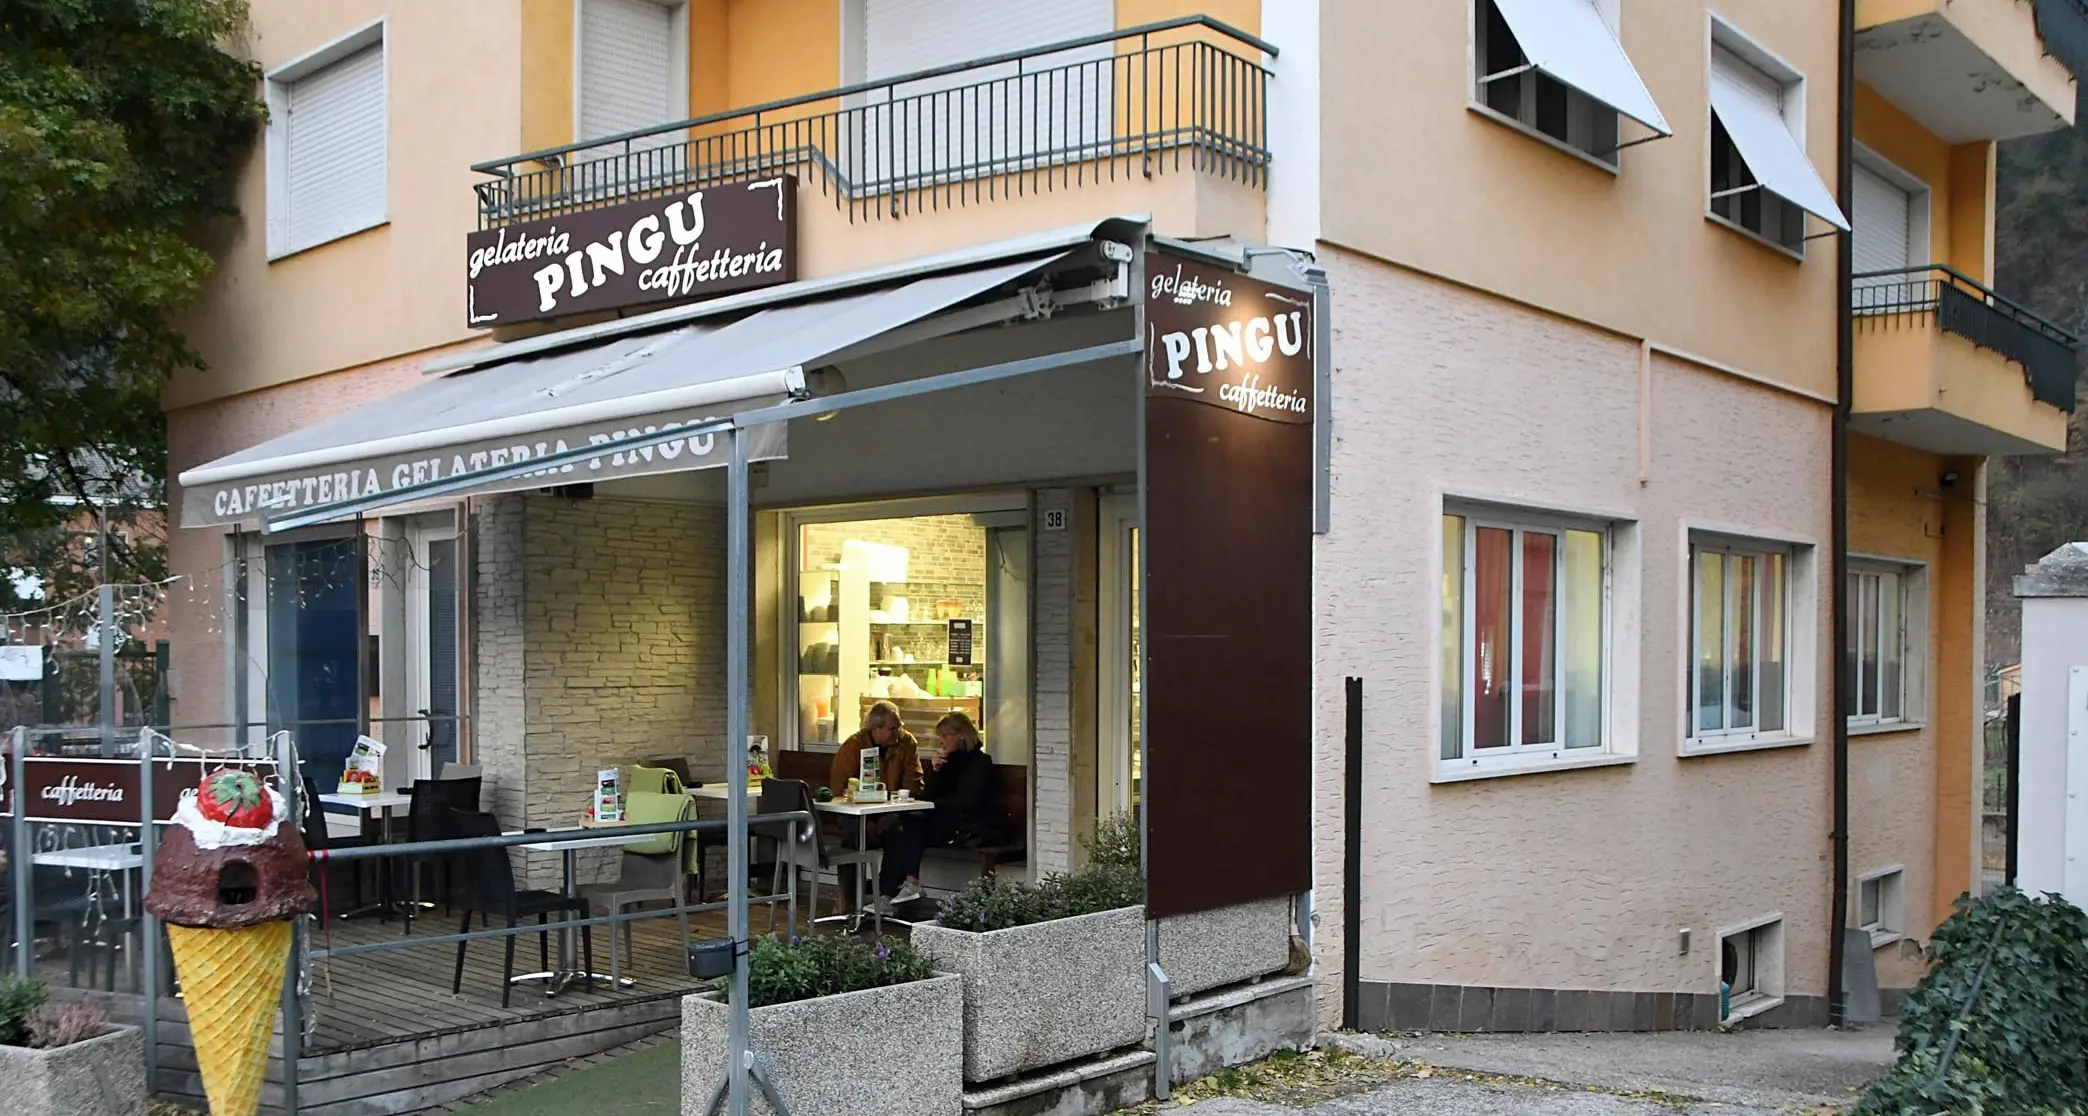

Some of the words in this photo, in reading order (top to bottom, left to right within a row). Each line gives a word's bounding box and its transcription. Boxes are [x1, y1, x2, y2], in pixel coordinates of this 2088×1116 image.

[469, 226, 570, 279] gelateria
[533, 191, 705, 313] PINGU
[638, 241, 784, 297] caffetteria
[1151, 263, 1232, 307] gelateria
[1161, 311, 1302, 379] PINGU
[1219, 372, 1307, 413] caffetteria
[214, 467, 382, 516] CAFFETTERIA
[1047, 511, 1062, 527] 38
[41, 775, 124, 806] caffetteria
